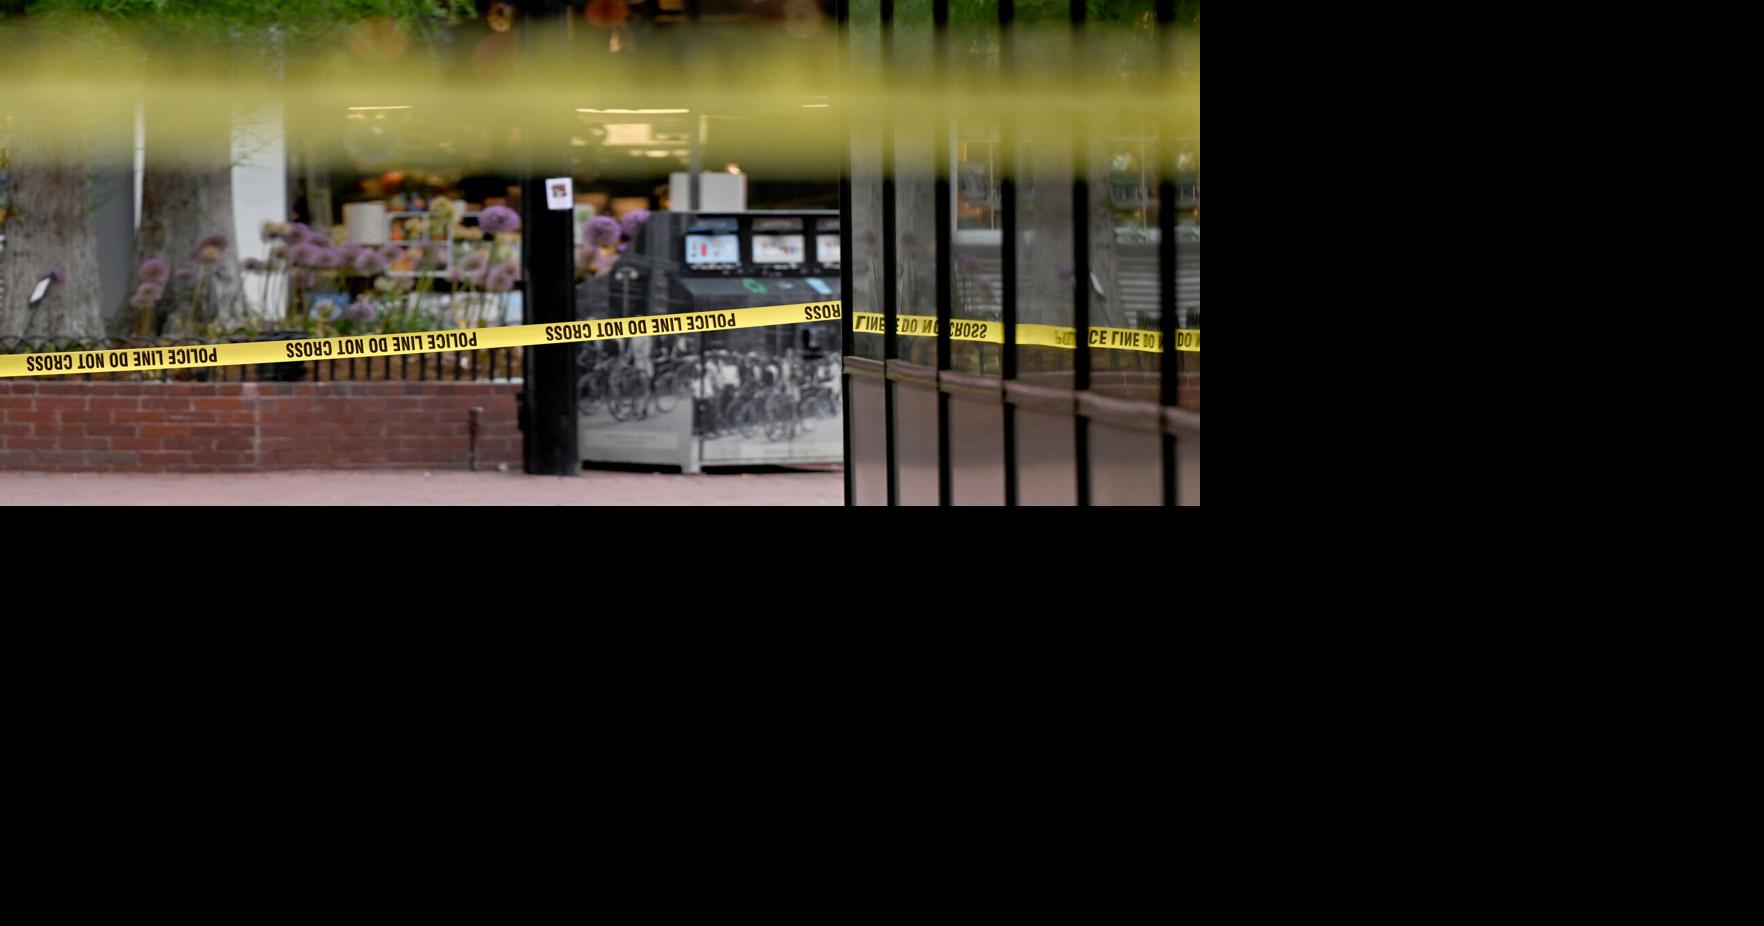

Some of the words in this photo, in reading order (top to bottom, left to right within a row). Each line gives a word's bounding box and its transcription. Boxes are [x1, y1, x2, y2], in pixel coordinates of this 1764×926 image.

[804, 304, 841, 320] ROSS
[596, 322, 624, 337] NOT
[628, 319, 647, 335] DO
[652, 317, 682, 333] LINE
[687, 313, 736, 330] POLICE
[427, 332, 478, 349] POLICE
[545, 324, 592, 341] CROSS
[286, 341, 332, 358] CROSS
[337, 339, 364, 355] NOT
[368, 338, 388, 353] DO
[392, 336, 423, 351] LINE
[27, 355, 73, 372] CROSS
[77, 353, 104, 369] NOT
[109, 352, 128, 368] DO
[133, 350, 164, 366] LINE
[168, 348, 217, 364] POLICE
